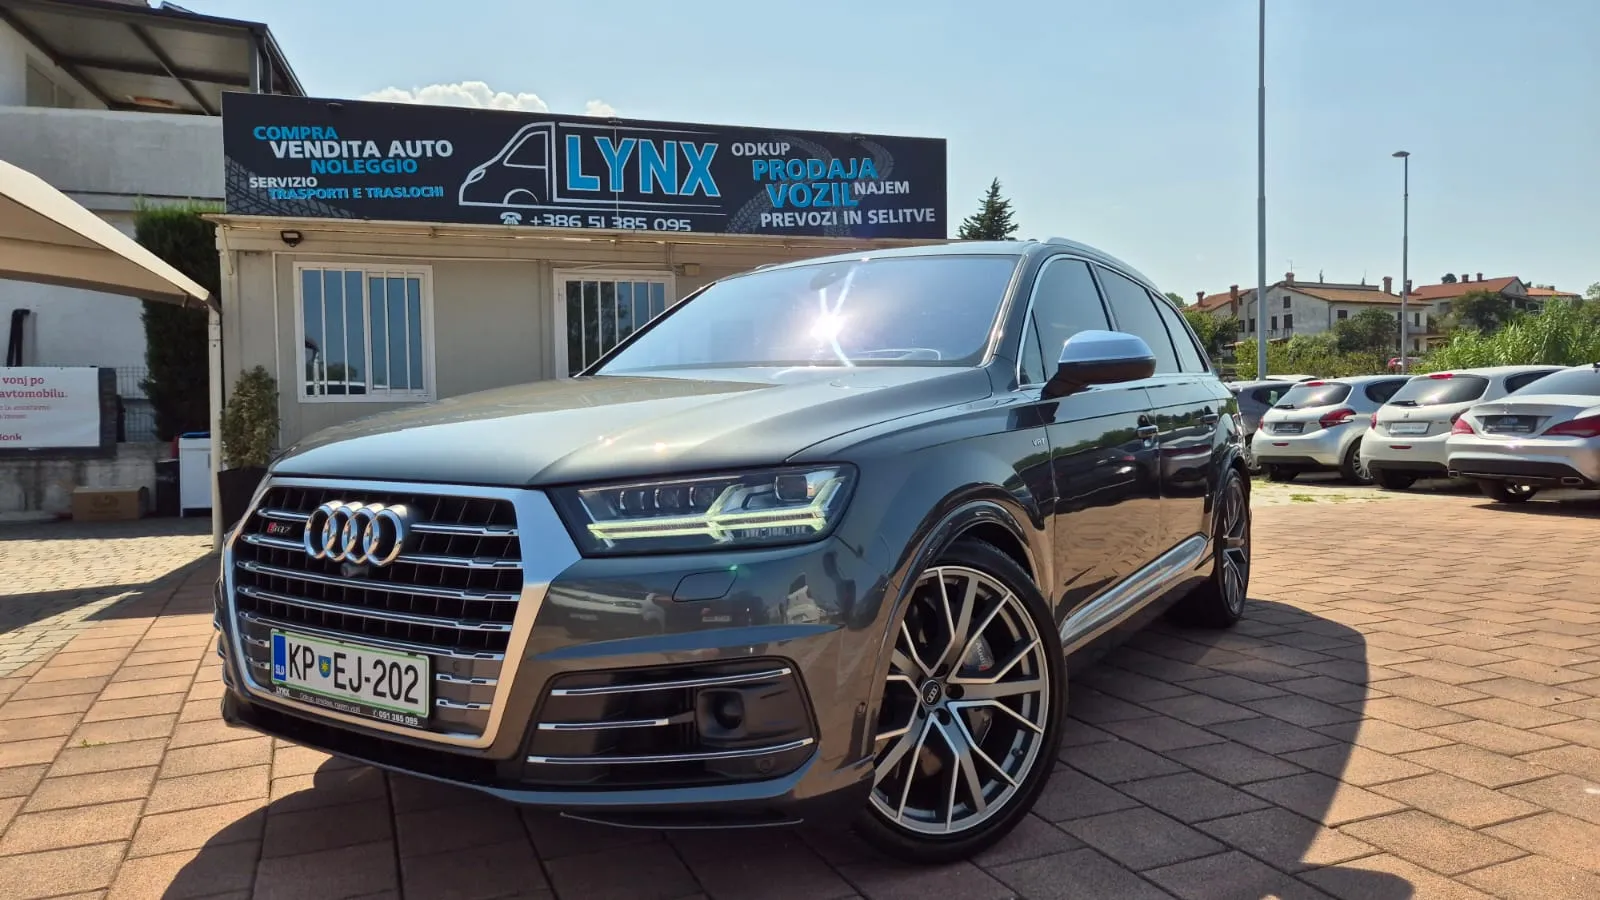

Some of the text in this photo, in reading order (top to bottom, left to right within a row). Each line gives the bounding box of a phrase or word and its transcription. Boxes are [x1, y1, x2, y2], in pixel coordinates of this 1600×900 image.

[253, 126, 338, 140] COMPRA
[270, 139, 454, 159] VENDITA AUTO
[731, 142, 791, 156] ODKUP
[311, 158, 418, 175] NOLEGGIO
[565, 134, 721, 198] LYNX
[752, 158, 878, 182] PRODAJA
[249, 176, 318, 188] SERVIZIO
[854, 181, 911, 195] NAJEM
[268, 185, 444, 200] TRASPORTI E TRASLOCHI
[765, 182, 859, 209] VOZIL
[530, 213, 692, 232] +386 51 385 095
[761, 208, 936, 228] PREVOZI IN SELITVE
[3, 376, 45, 387] vonj po
[288, 642, 315, 681] KP
[333, 652, 419, 705] EJ-202
